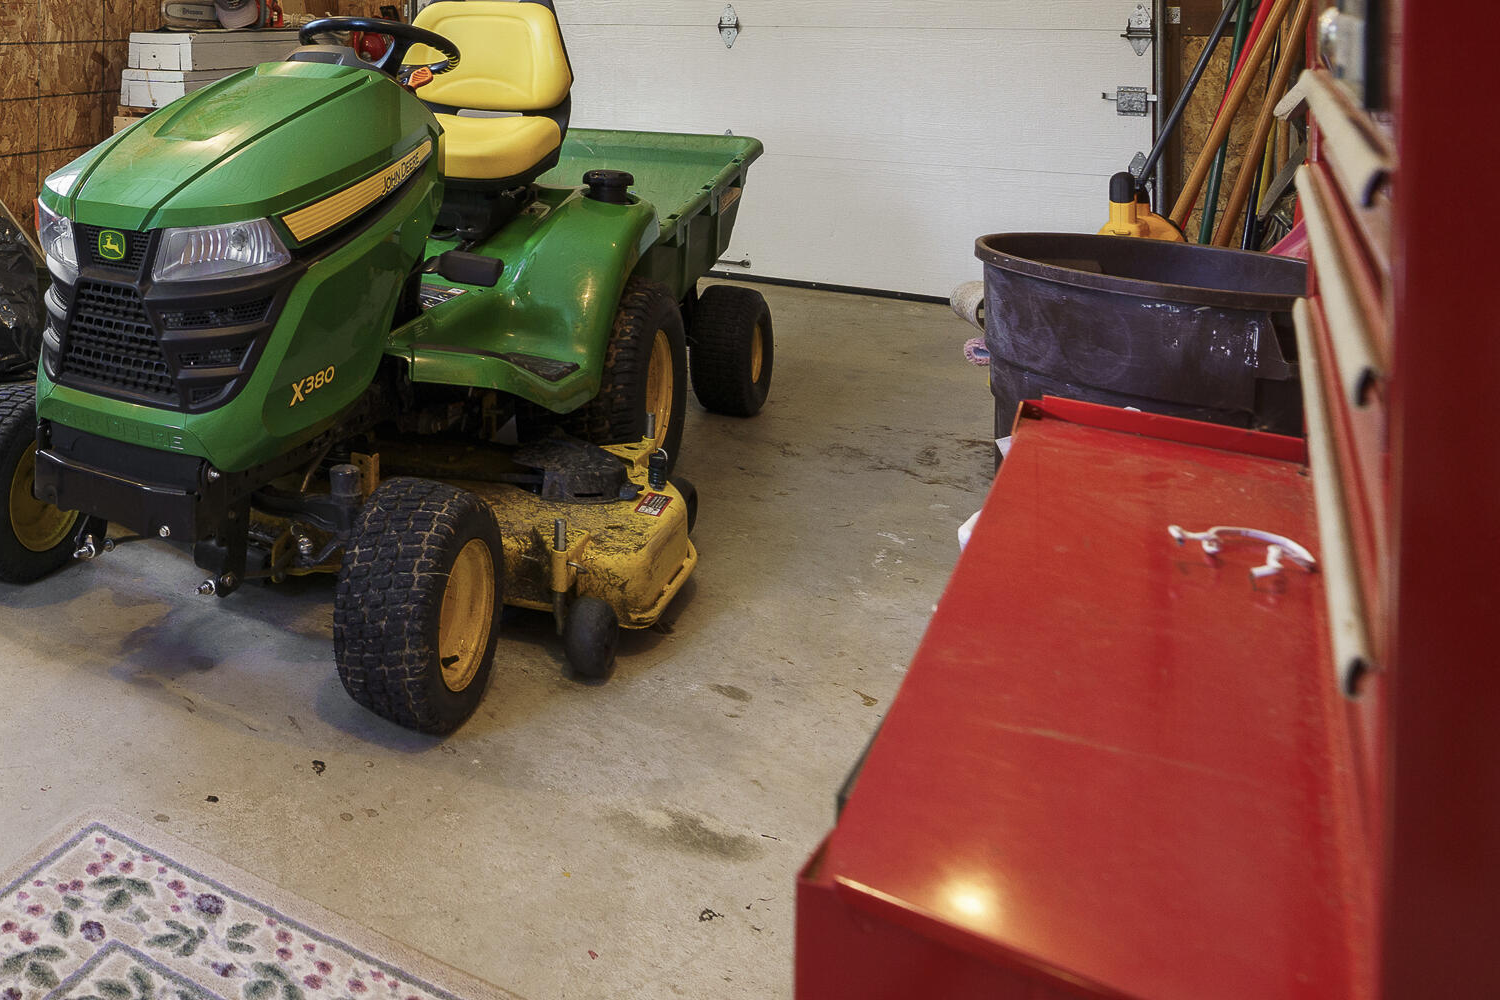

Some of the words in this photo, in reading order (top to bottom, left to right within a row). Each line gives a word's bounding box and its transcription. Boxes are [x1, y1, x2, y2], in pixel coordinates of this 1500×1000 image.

[381, 168, 401, 196] JOHN
[400, 152, 420, 181] DEERE
[289, 365, 335, 407] X380
